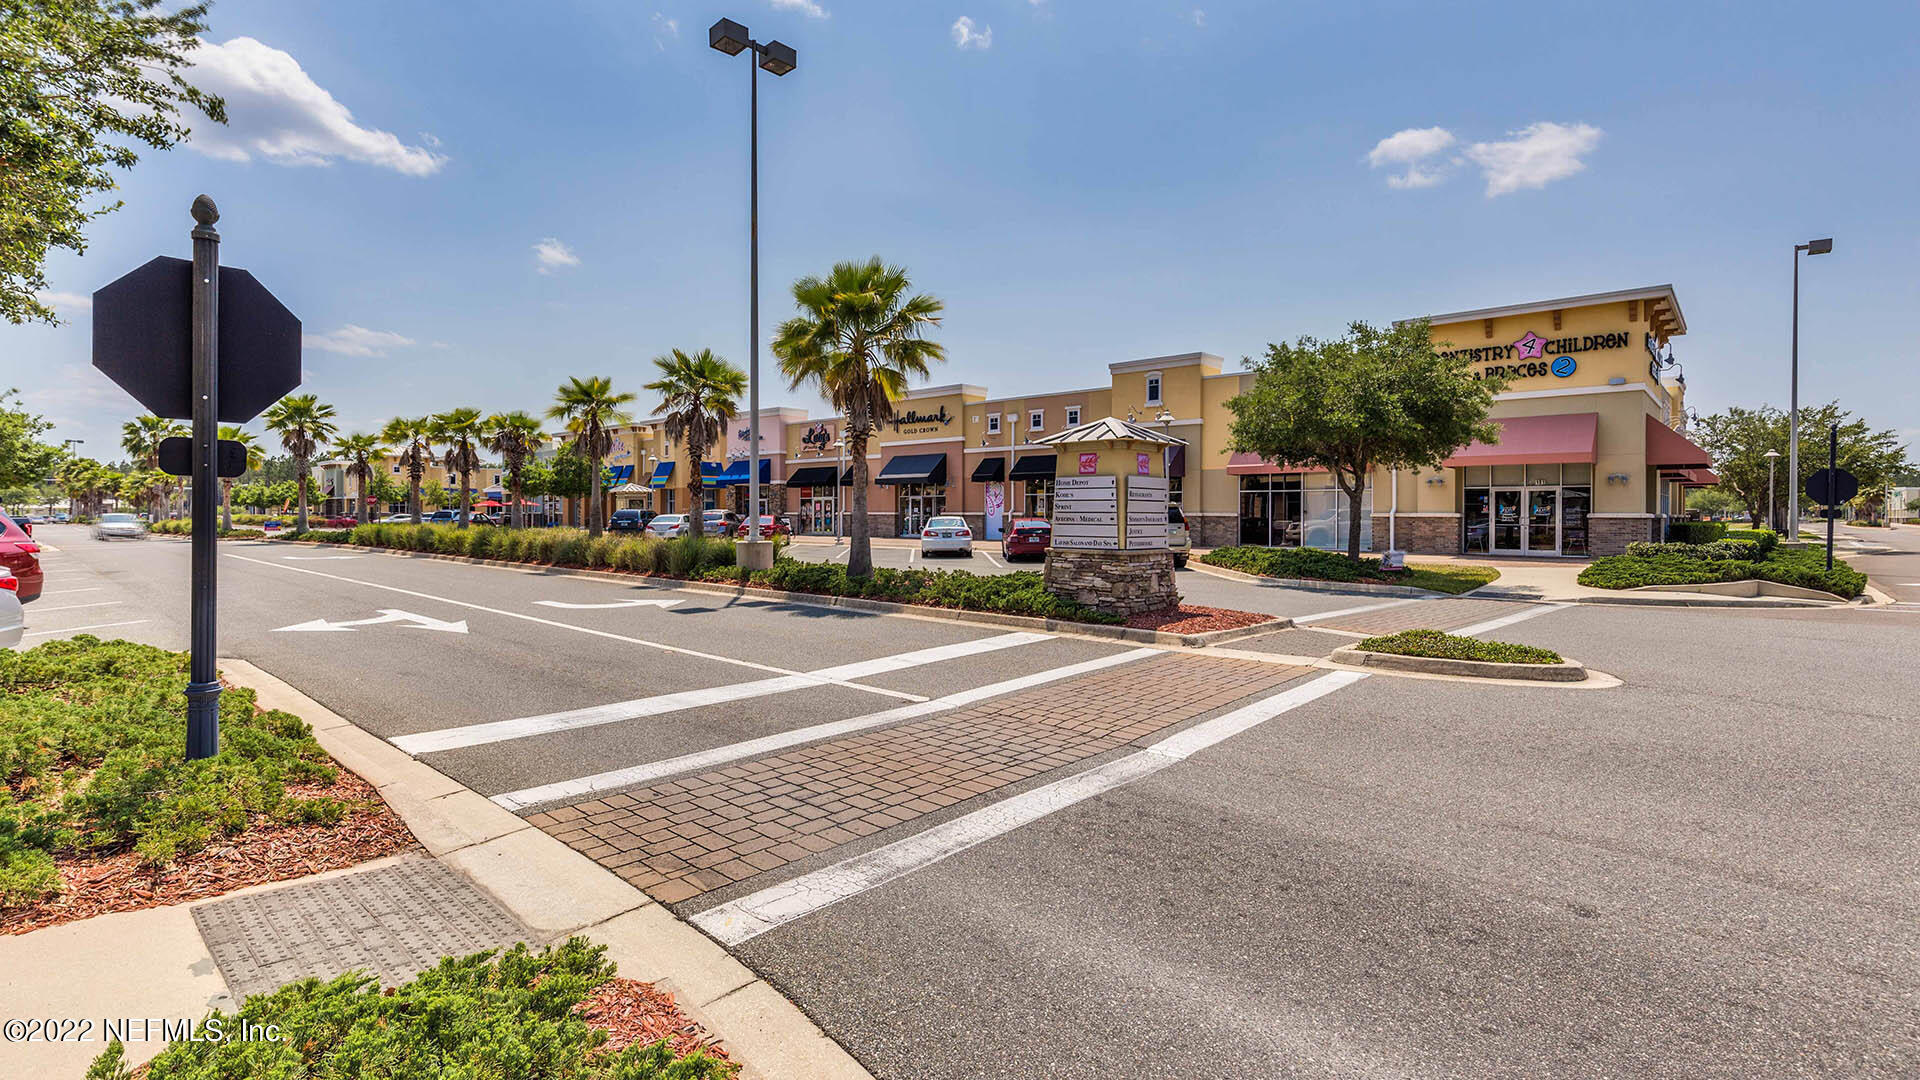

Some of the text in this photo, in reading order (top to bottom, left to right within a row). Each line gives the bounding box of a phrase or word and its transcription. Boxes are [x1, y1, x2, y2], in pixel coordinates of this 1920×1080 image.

[1521, 338, 1537, 354] 4
[1556, 358, 1571, 374] 2
[888, 405, 951, 433] Hallmark
